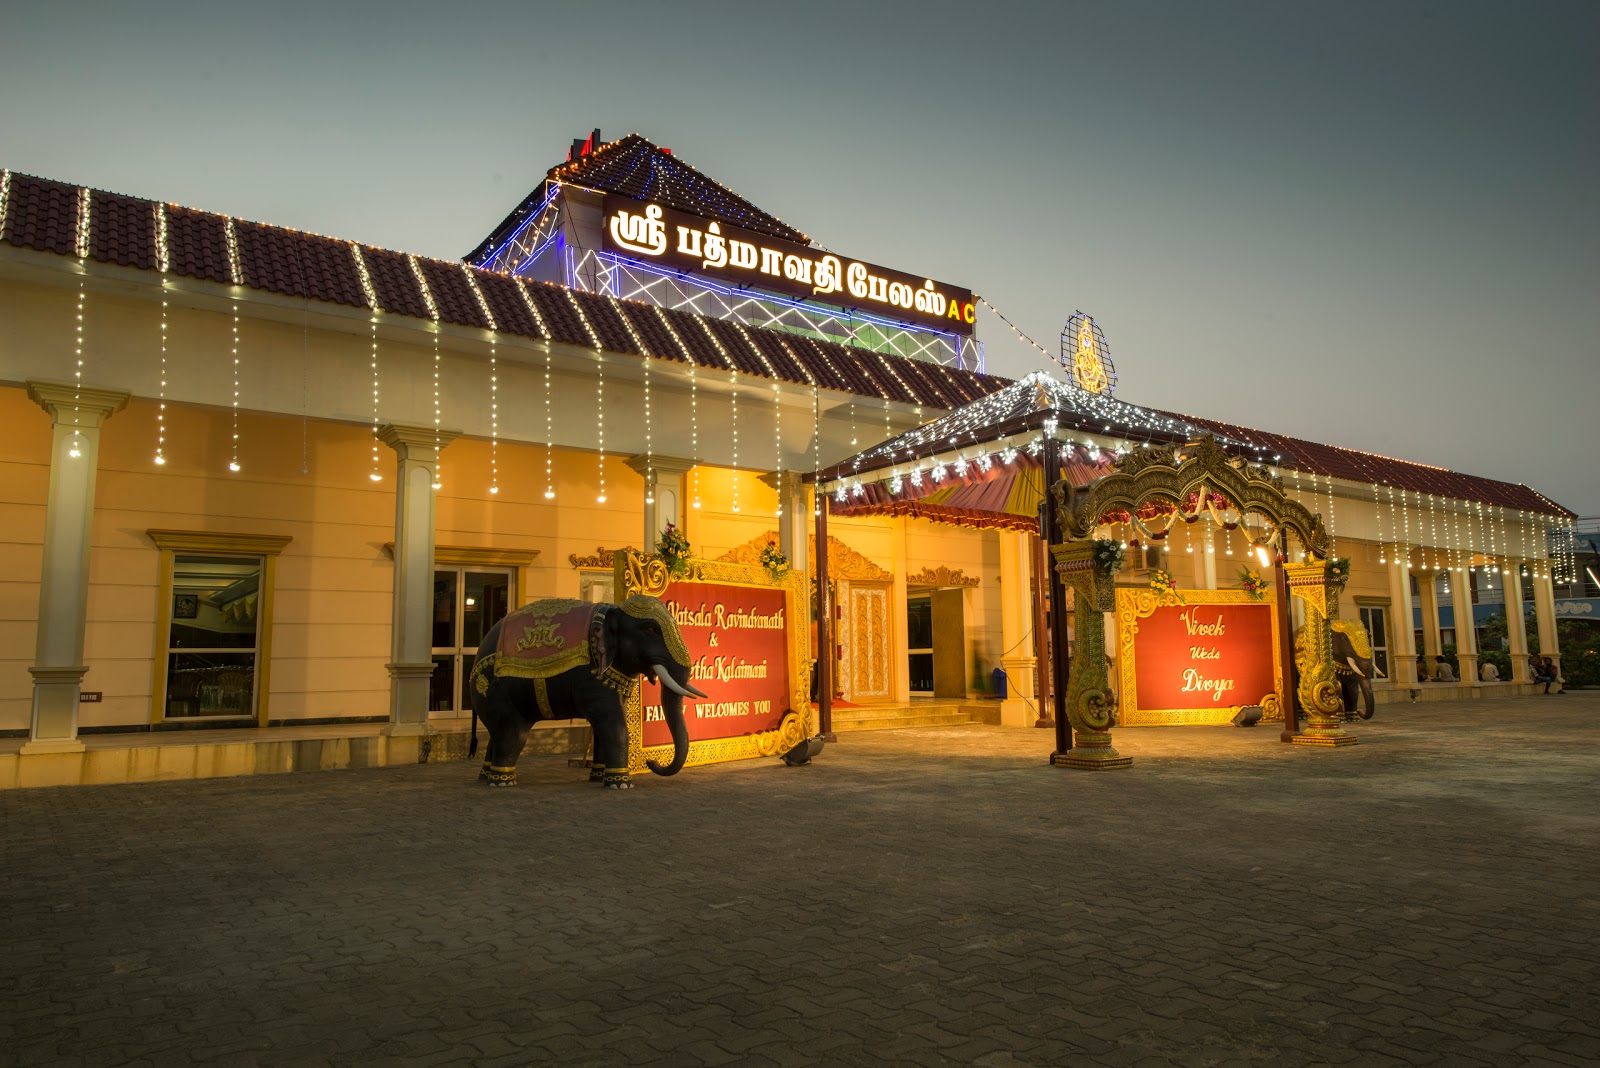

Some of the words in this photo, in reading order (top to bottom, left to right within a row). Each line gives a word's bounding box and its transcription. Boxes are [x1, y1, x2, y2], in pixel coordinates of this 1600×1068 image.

[676, 222, 843, 296] பத்மாவதி
[846, 262, 946, 316] பேலஸ்
[947, 299, 975, 324] A/C
[715, 603, 784, 630] Ravindranath
[1180, 606, 1226, 636] Vivek
[709, 632, 719, 647] &
[1189, 646, 1221, 660] Weds
[715, 656, 767, 683] Kalaimani
[1181, 668, 1235, 701] Divya
[695, 701, 750, 719] WELCOMES
[754, 700, 771, 714] YOU
